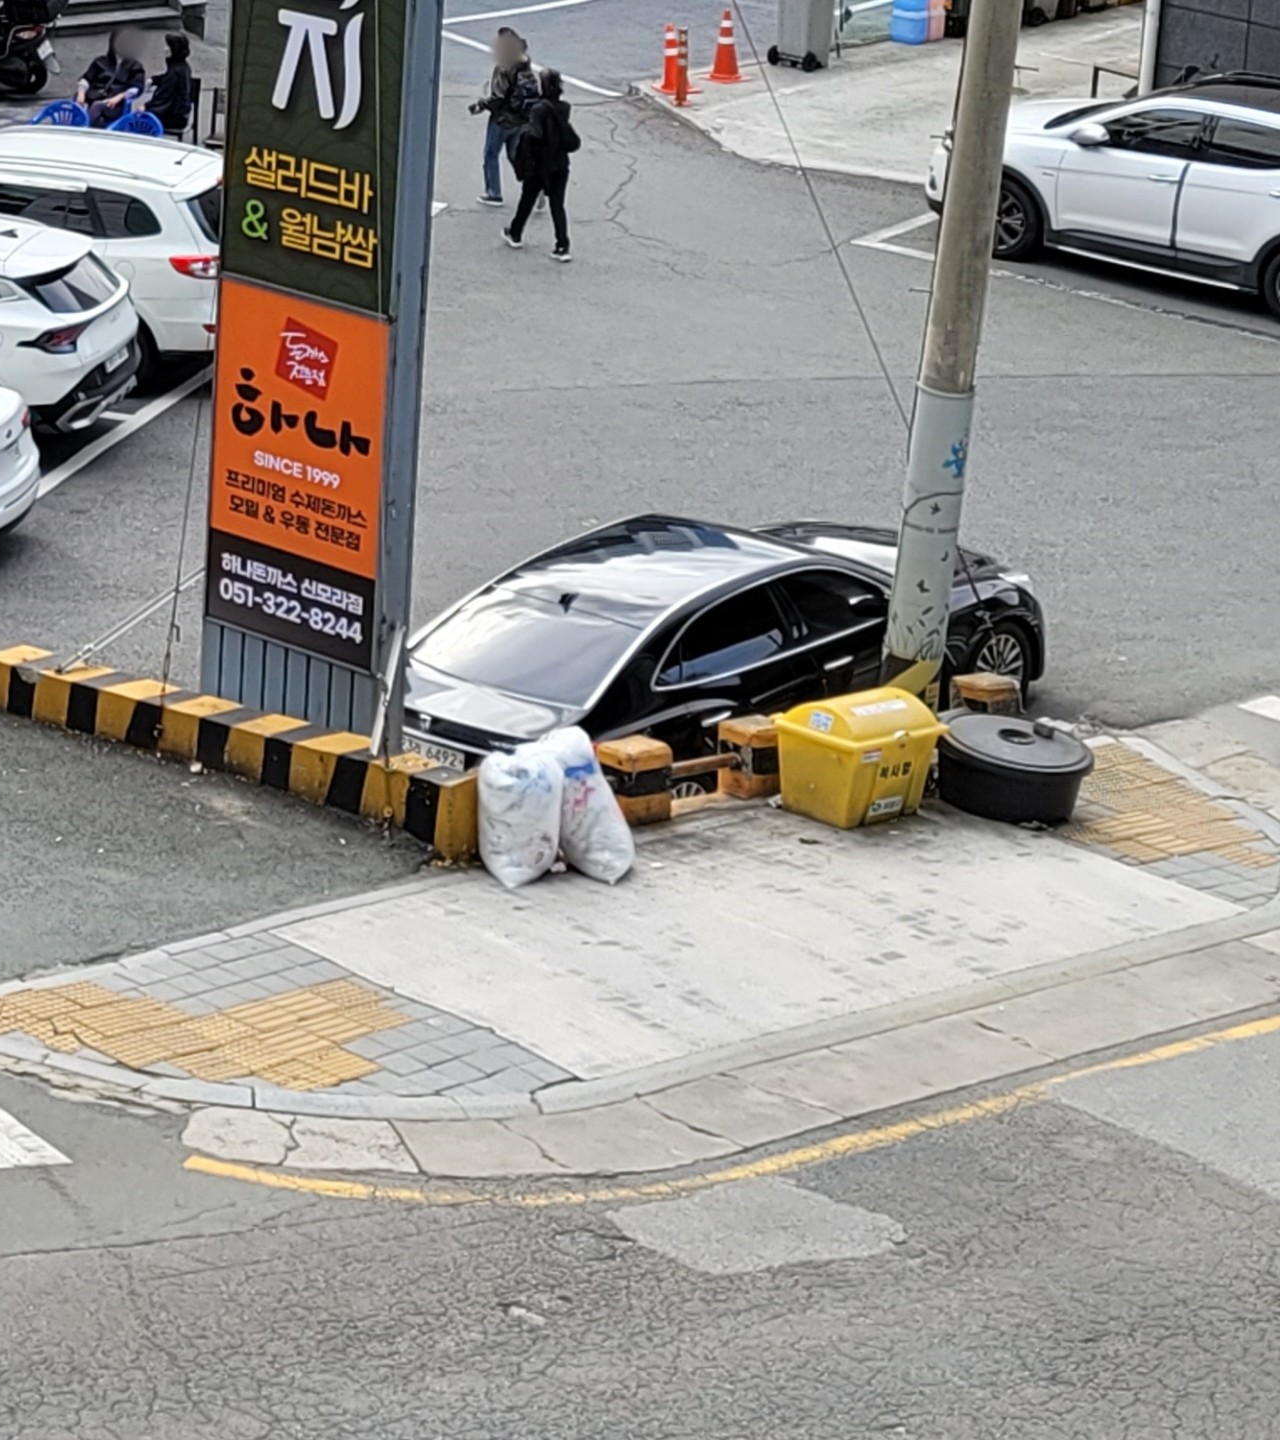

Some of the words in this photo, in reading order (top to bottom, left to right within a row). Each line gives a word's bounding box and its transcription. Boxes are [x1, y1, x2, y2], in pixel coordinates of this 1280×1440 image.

[243, 145, 375, 215] 샐러드바
[241, 198, 269, 241] &
[279, 206, 378, 269] 월남쌈
[231, 366, 372, 458] 하나
[225, 468, 287, 504] 프리미엄
[290, 488, 369, 530] 수제돈까스
[253, 450, 304, 479] SINCE
[305, 465, 342, 490] 1999
[229, 494, 260, 521] 모밀
[263, 503, 276, 525] &
[279, 510, 311, 536] 우동
[314, 518, 362, 552] 전문점
[219, 577, 364, 645] 051-322-8244
[220, 551, 299, 594] 하나돈까스
[300, 577, 365, 616] 신모라점
